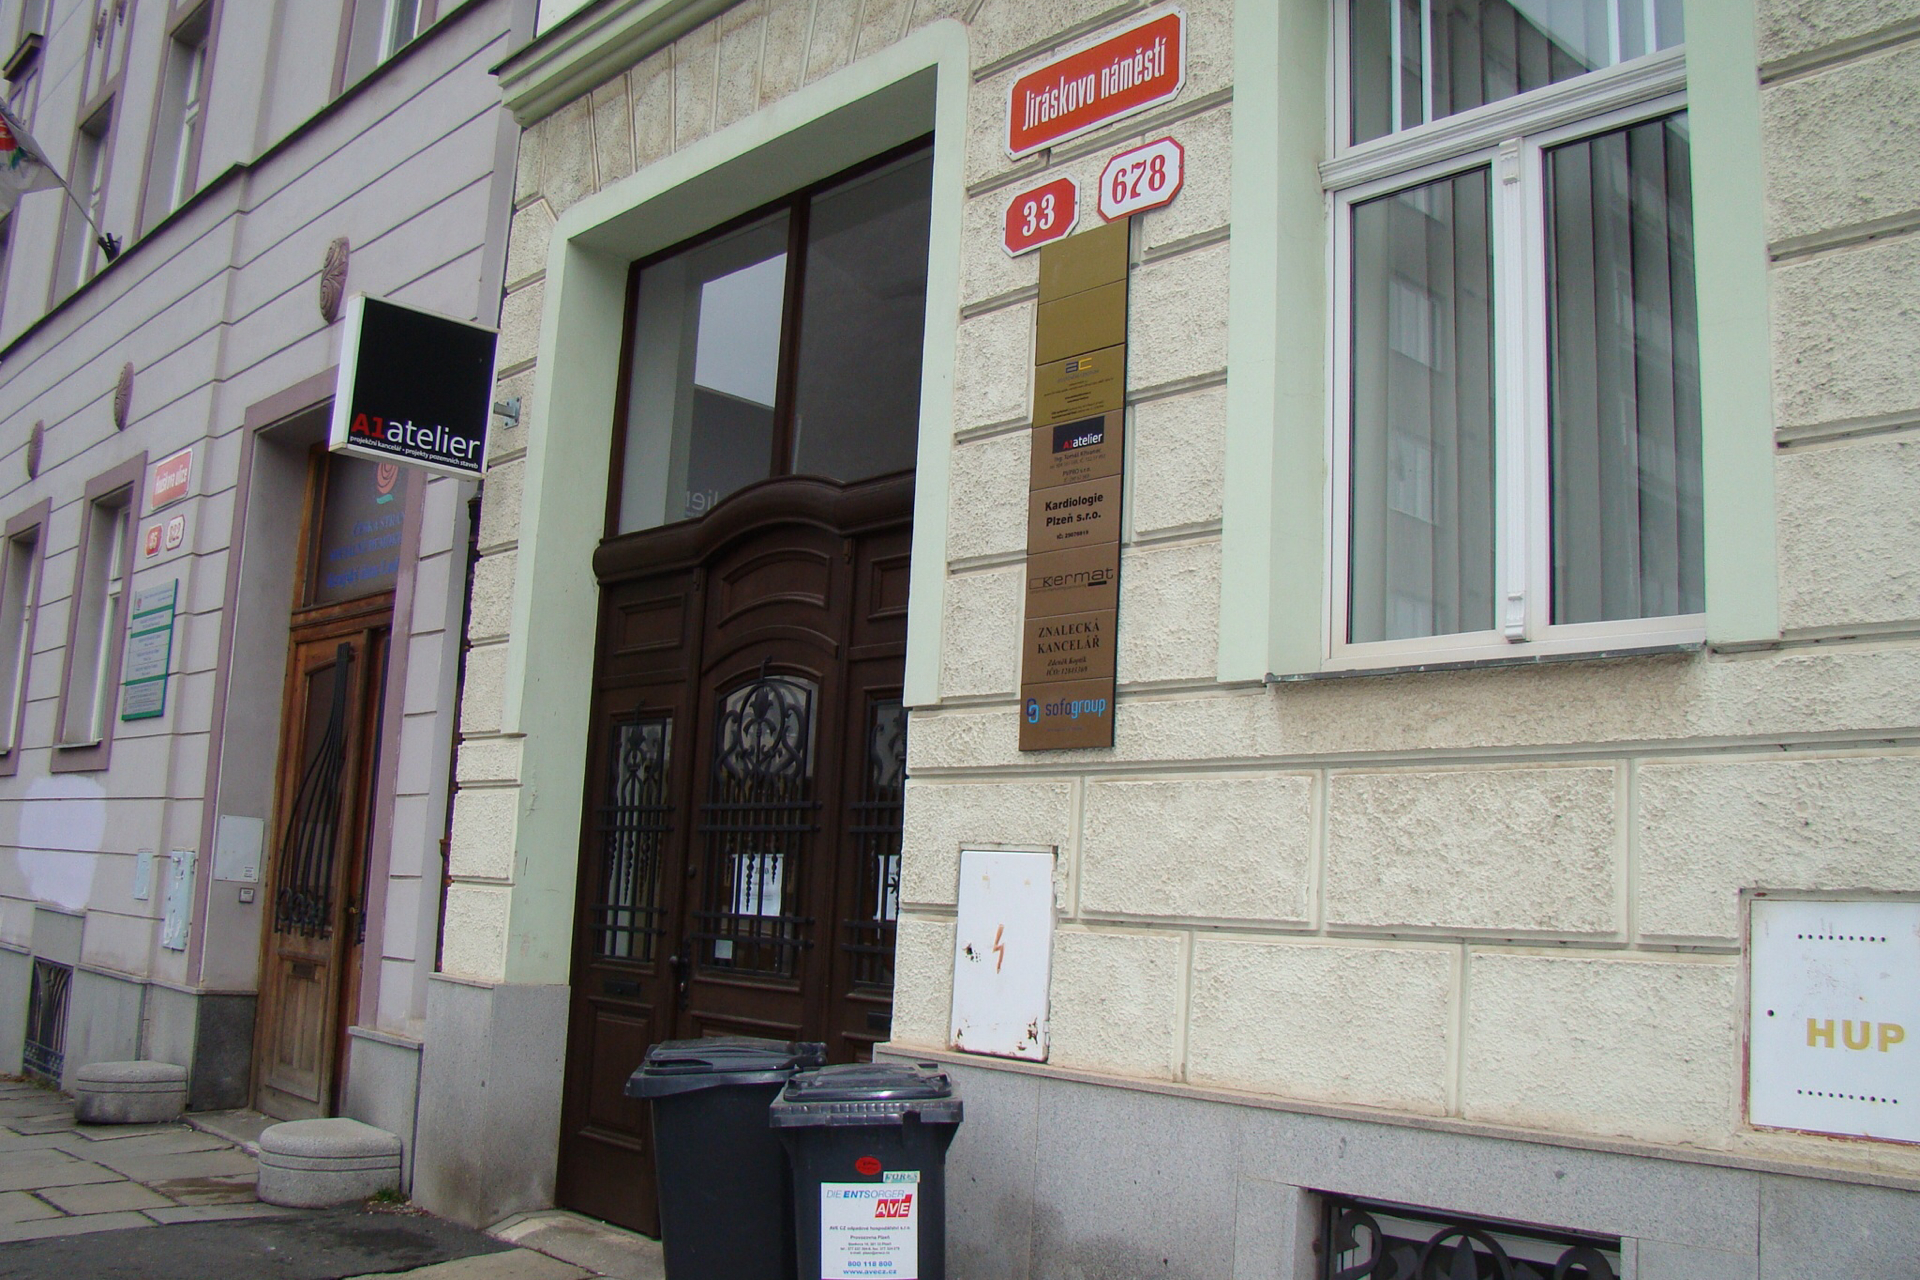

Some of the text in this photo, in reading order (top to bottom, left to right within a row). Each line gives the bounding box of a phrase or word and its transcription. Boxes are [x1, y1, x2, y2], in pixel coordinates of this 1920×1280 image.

[1022, 37, 1166, 131] Jiráskovo náměstí
[1111, 154, 1166, 205] 678
[1022, 194, 1055, 236] 33
[350, 413, 481, 459] A1atelier
[1063, 433, 1103, 450] A1atelier
[349, 435, 377, 448] projekční
[377, 440, 402, 452] kancelář
[405, 447, 429, 459] projekty
[460, 460, 479, 469] staveb
[1045, 493, 1104, 511] Kardiologie
[1046, 512, 1102, 527] Plzeň s.r.o.
[1038, 618, 1100, 638] ZNALECKÁ
[1037, 635, 1100, 654] KANCELÁŘ
[1045, 698, 1106, 719] sofogroup
[1806, 1018, 1906, 1052] HUP
[826, 1189, 905, 1198] DIE ENTSORGER
[876, 1202, 910, 1215] AVE
